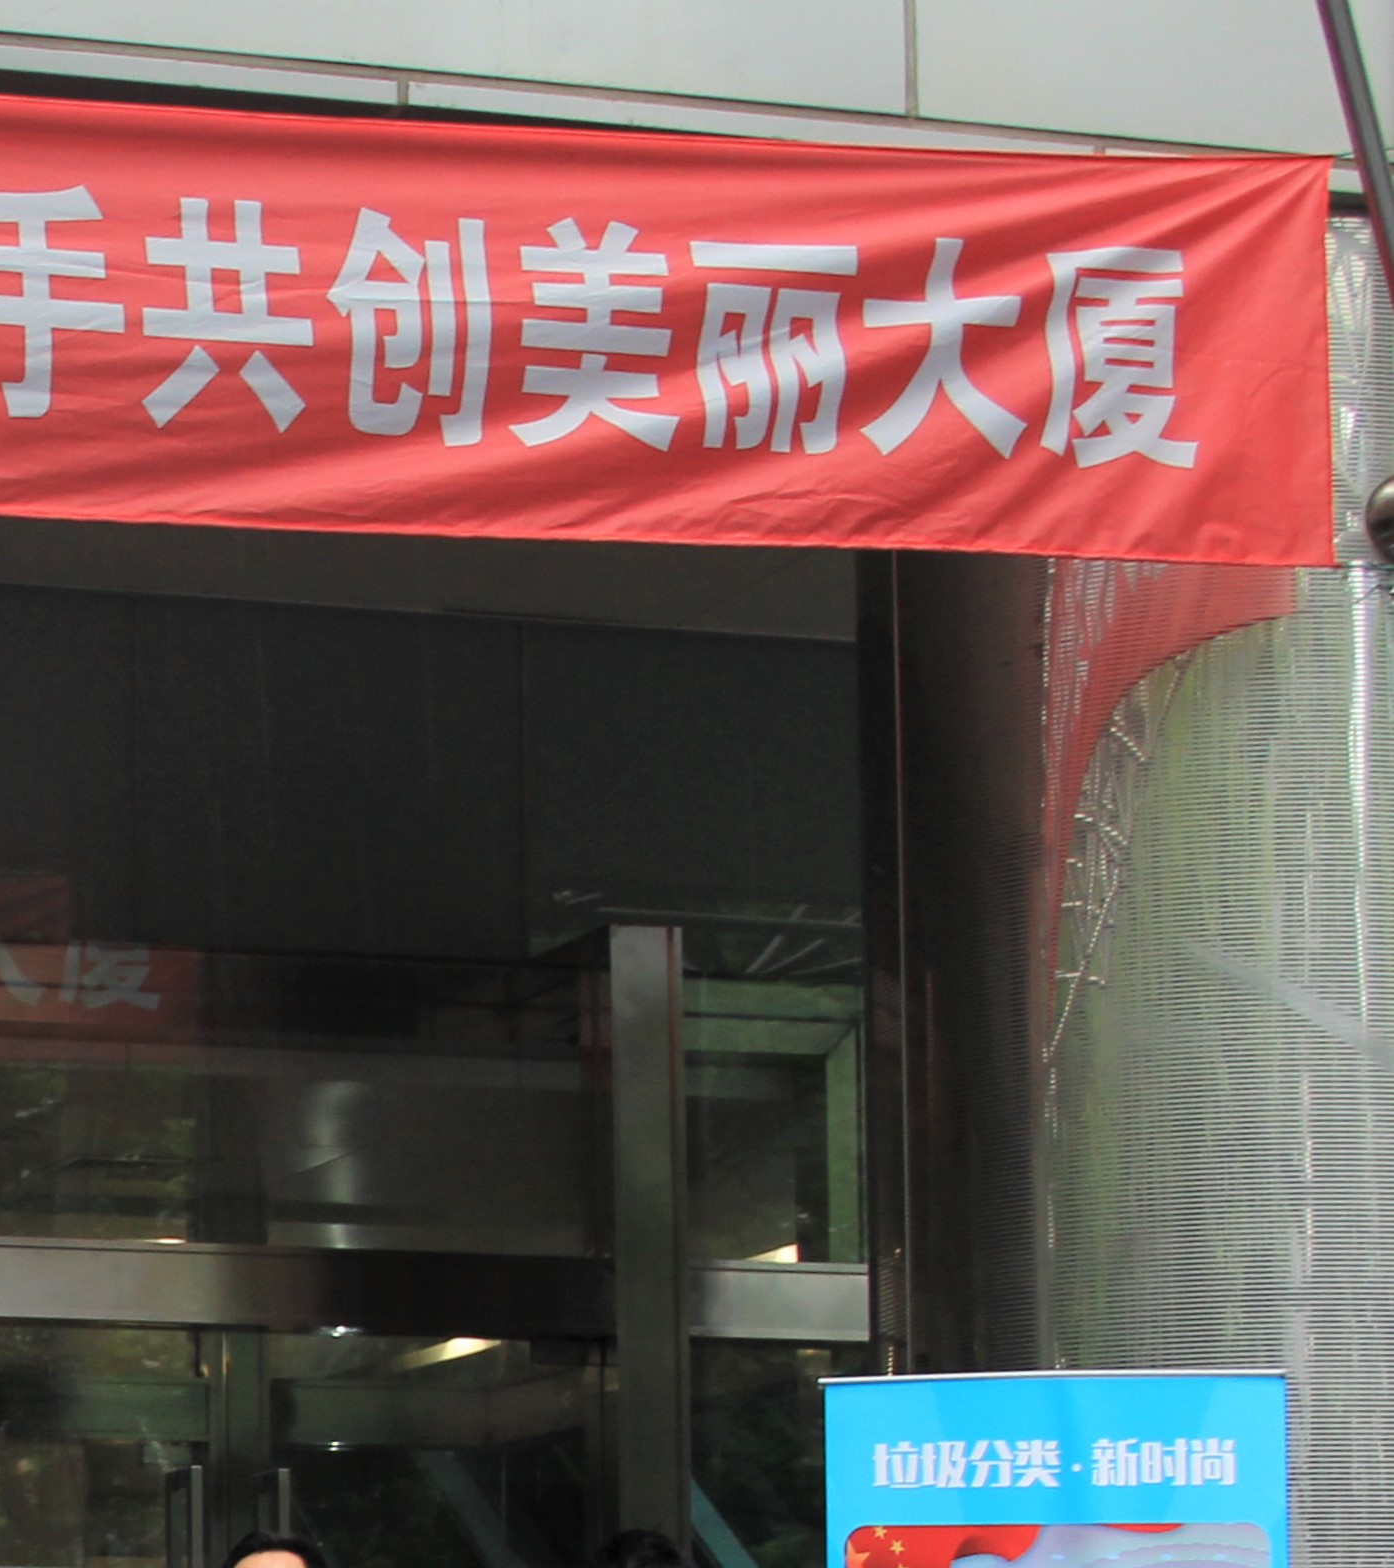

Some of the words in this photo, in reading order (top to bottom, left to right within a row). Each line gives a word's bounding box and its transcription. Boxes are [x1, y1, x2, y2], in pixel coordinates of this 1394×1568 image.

[871, 1437, 1238, 1490] 垃圾分类·新时尚
